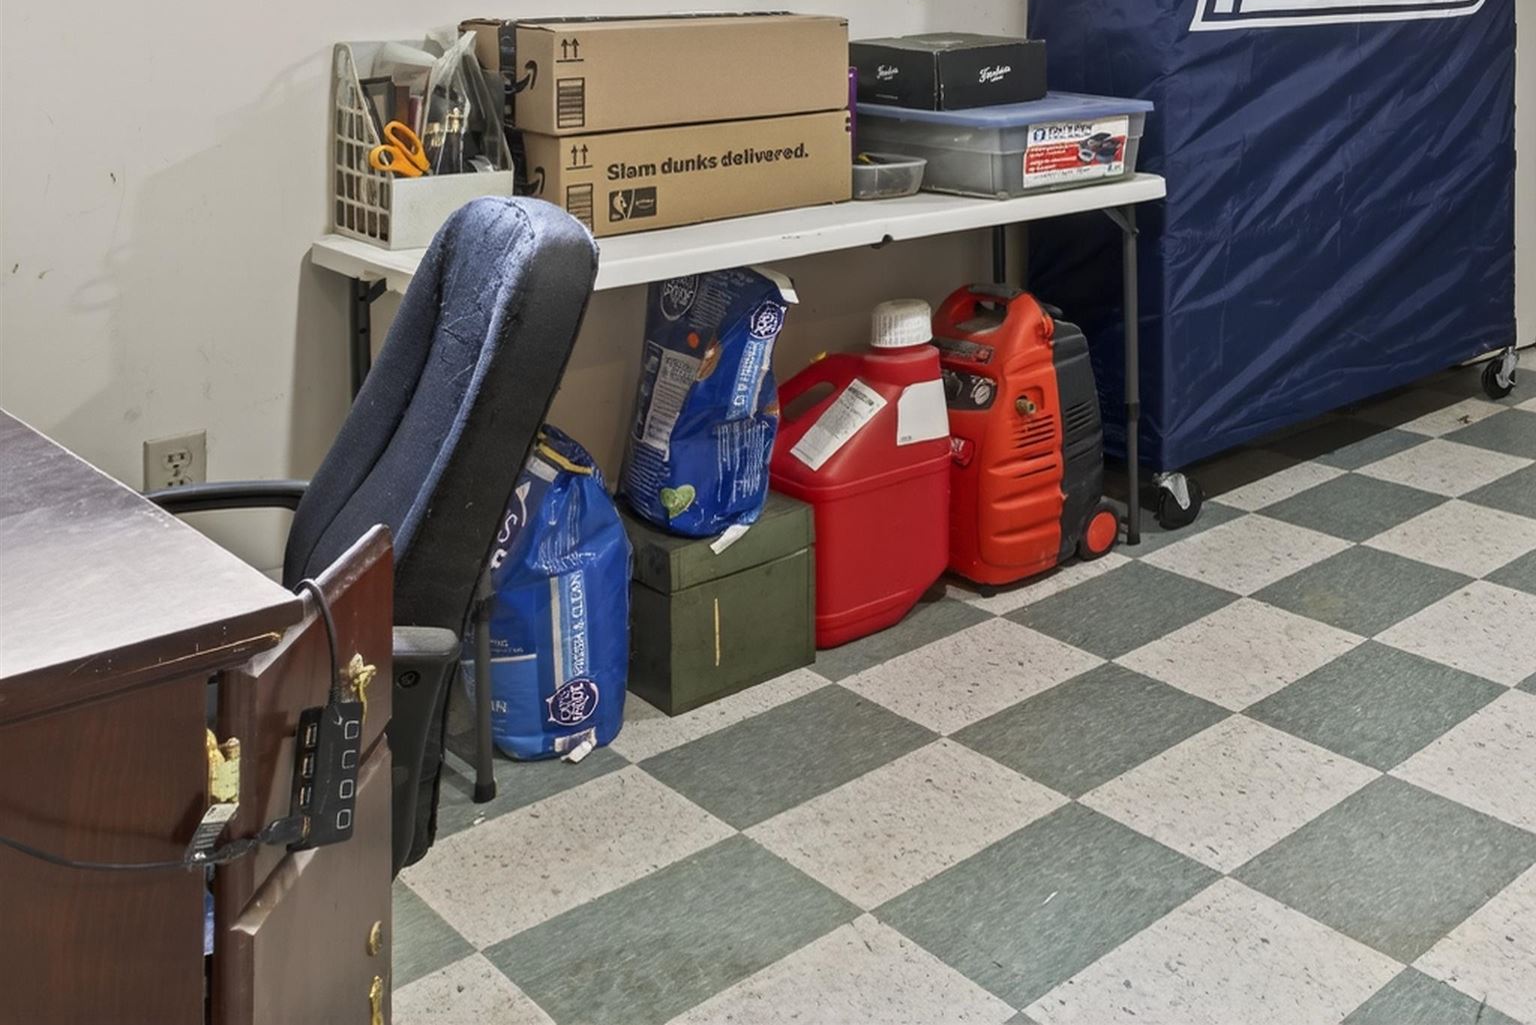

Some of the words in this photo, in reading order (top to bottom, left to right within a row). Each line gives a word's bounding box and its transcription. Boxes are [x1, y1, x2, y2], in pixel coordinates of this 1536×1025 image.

[607, 162, 657, 181] Slam
[660, 154, 717, 174] dunks
[720, 142, 809, 167] delivered.
